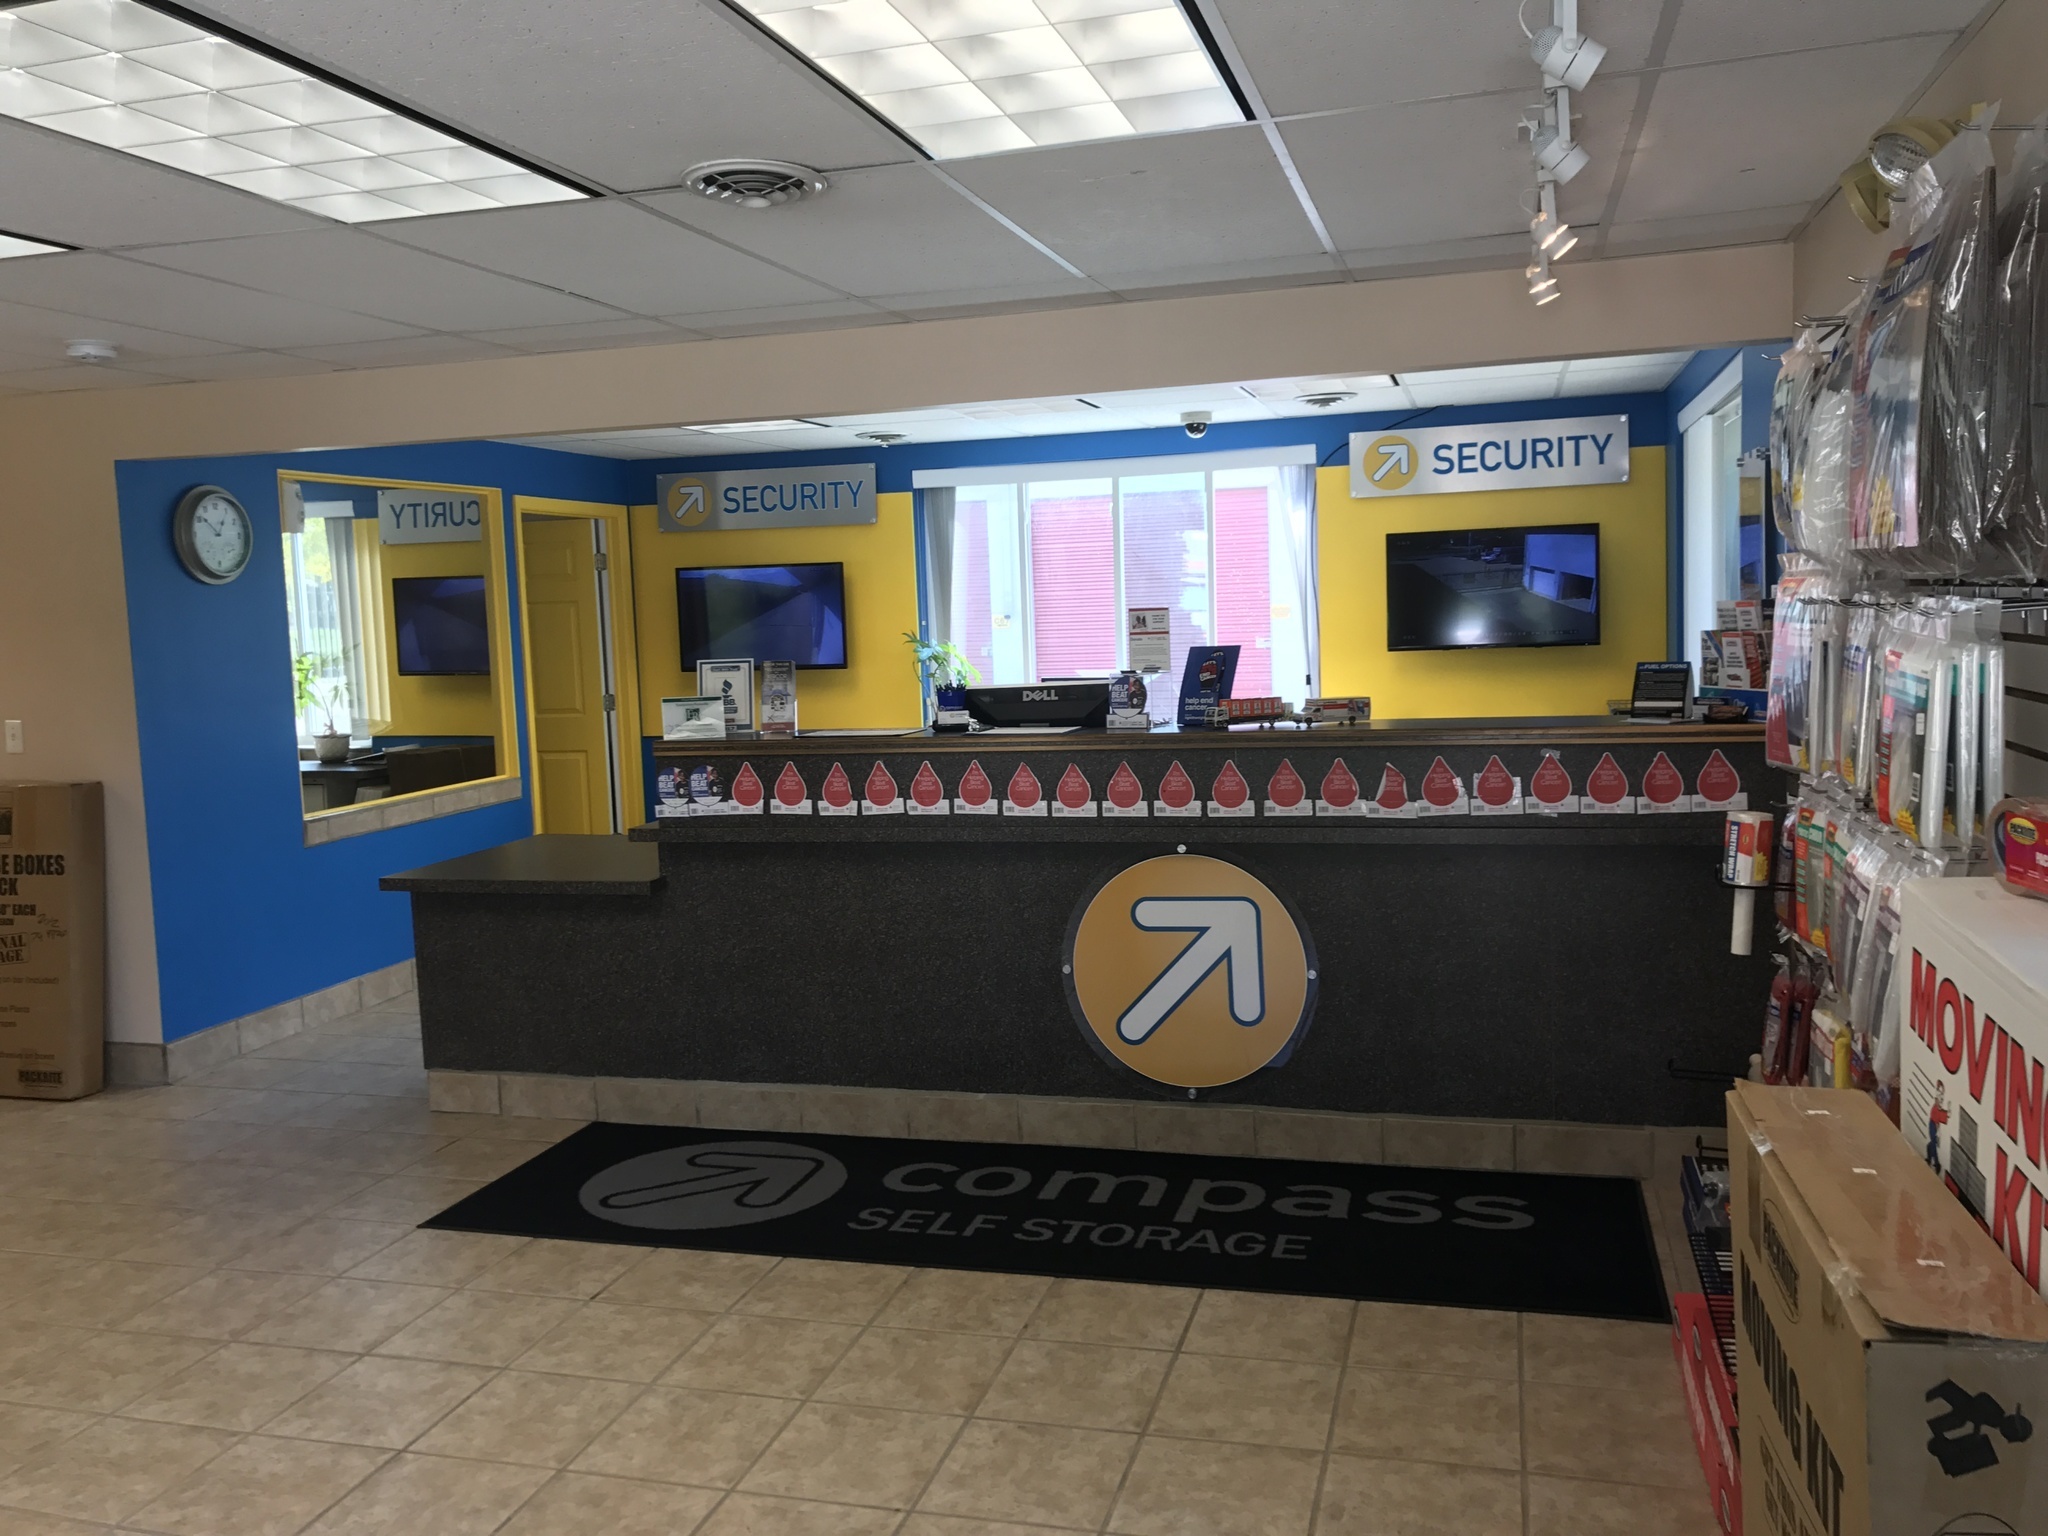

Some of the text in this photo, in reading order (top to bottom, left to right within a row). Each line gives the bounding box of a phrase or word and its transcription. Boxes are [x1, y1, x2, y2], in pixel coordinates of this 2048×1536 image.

[1432, 433, 1614, 475] SECURITY
[722, 480, 865, 514] SECURITY
[1022, 690, 1059, 702] DELL
[13, 854, 65, 876] BOXES
[1727, 825, 1738, 879] STRETCH WRAP
[12, 904, 36, 916] EACH
[1909, 945, 2048, 1173] MOVIN
[880, 1161, 1535, 1231] compass
[1993, 1142, 2048, 1296] KI
[847, 1203, 1313, 1262] SELF STORAGE
[1740, 1247, 1802, 1471] MOVING
